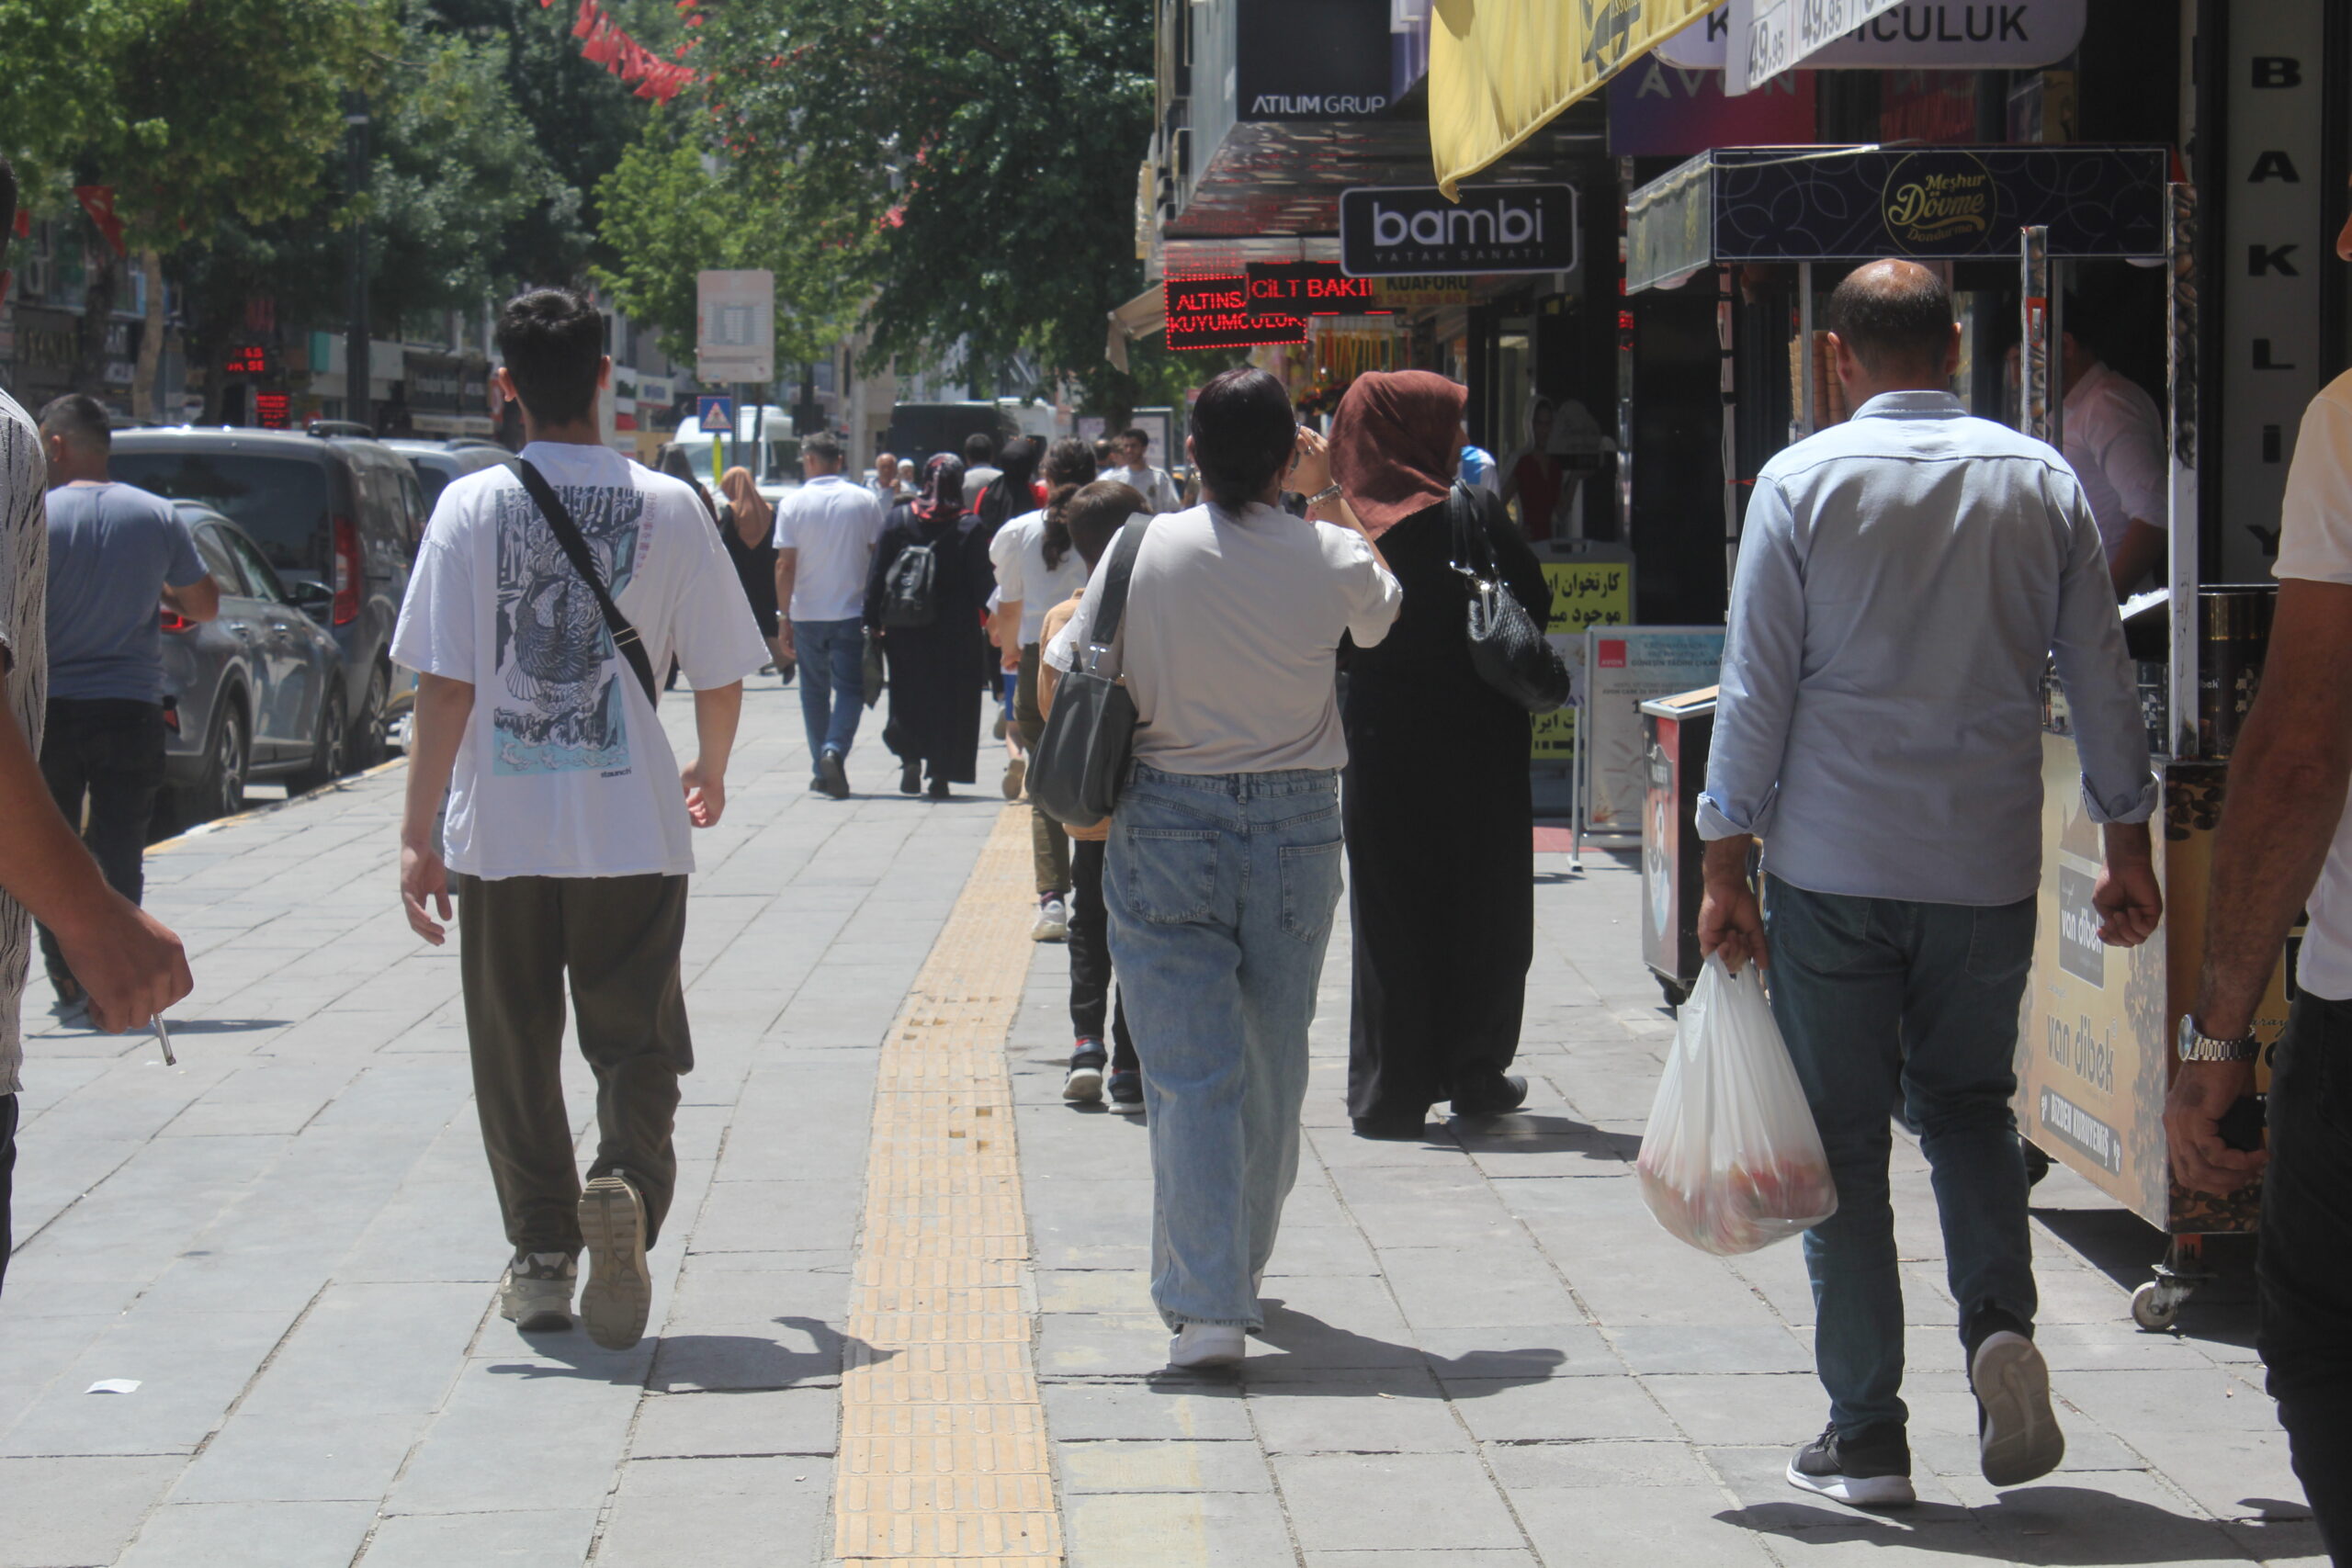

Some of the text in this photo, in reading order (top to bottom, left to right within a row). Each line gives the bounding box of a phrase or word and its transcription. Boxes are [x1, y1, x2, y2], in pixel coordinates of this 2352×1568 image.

[1707, 5, 2028, 42] KCULUK
[1748, 20, 1784, 82] 49.95
[1634, 62, 1796, 99] AVN
[1251, 95, 1386, 114] ATILIM GRUP
[1925, 173, 1985, 192] Meşhur
[1373, 198, 1543, 246] bambi
[1888, 184, 1985, 226] Dövme
[1906, 225, 1973, 242] Dondurma
[1374, 249, 1544, 263] YATAK SANATI
[1176, 291, 1247, 311] ALTINS
[1307, 278, 1373, 299] BAKI
[2061, 907, 2102, 954] van dibek
[2046, 1013, 2114, 1096] van dibek
